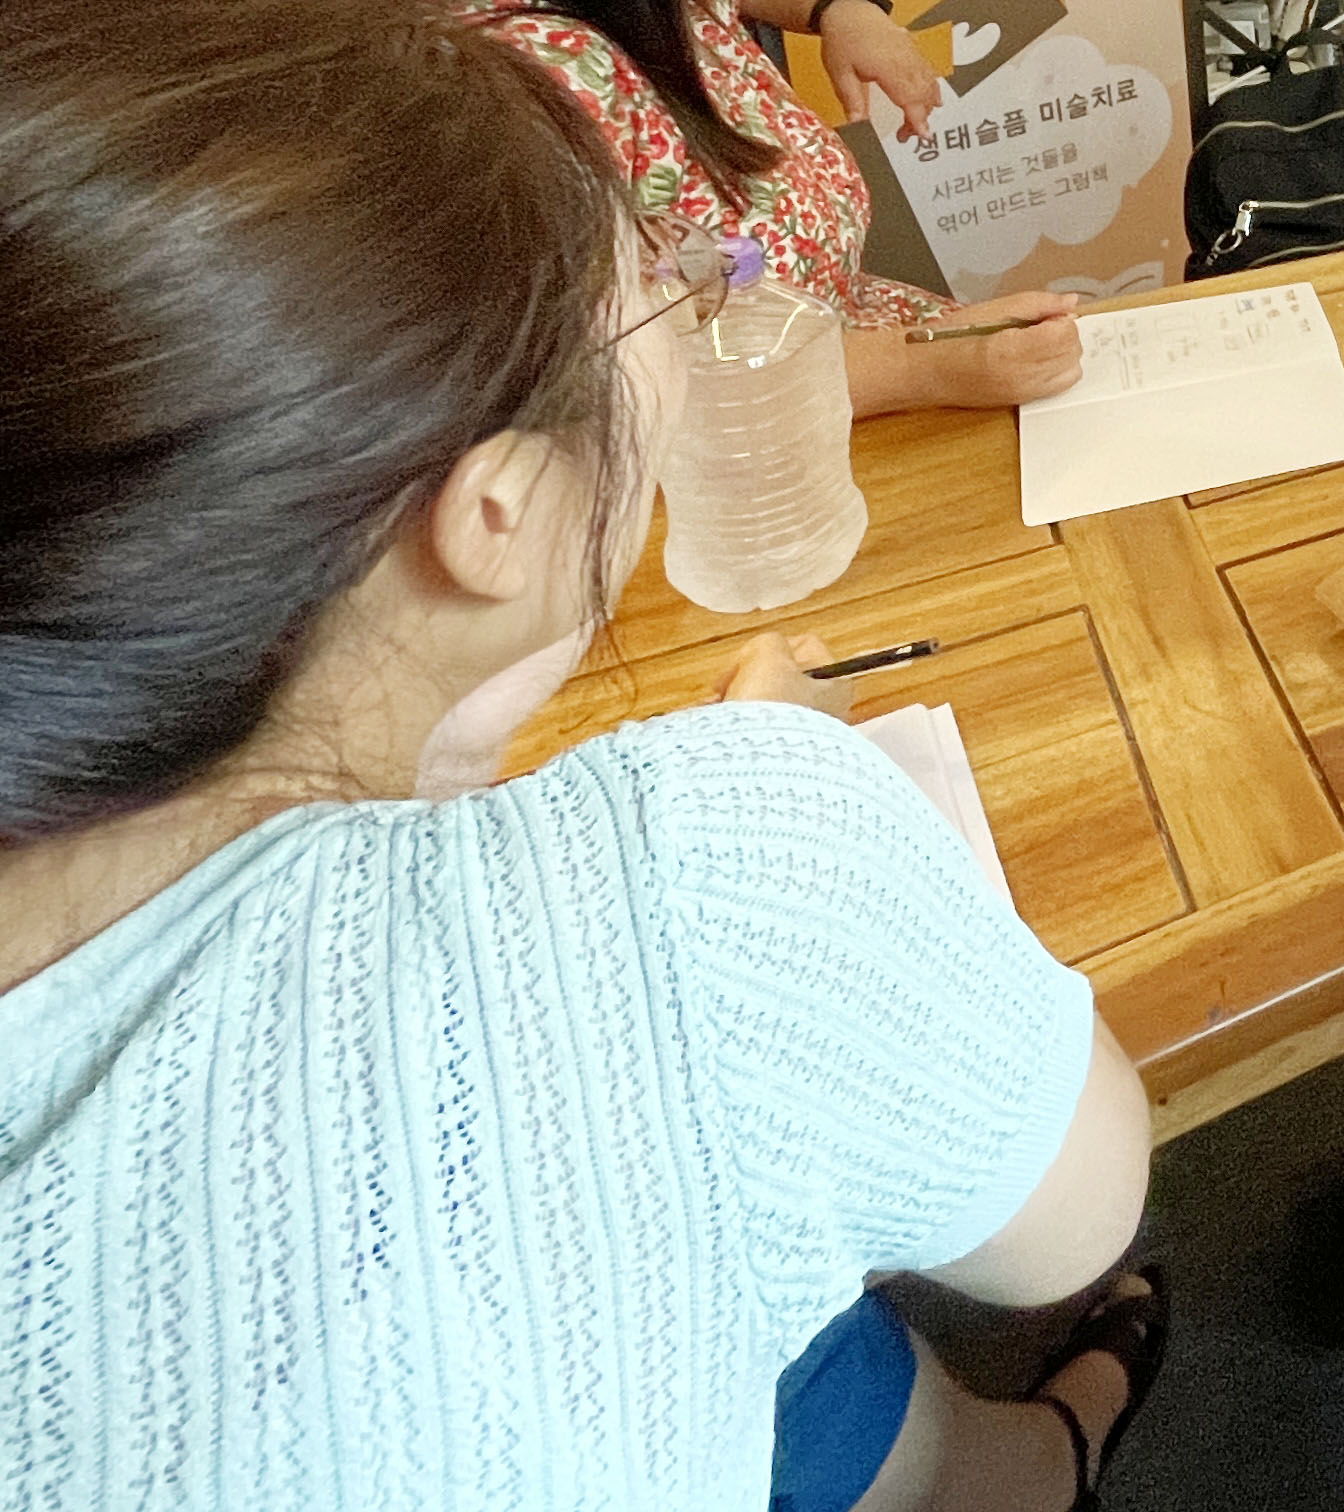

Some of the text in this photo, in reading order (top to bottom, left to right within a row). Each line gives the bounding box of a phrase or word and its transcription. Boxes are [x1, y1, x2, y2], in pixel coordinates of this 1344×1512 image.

[913, 79, 1138, 163] 생태슬픔 미술치료
[932, 142, 1078, 202] 사라지는 것들을
[936, 163, 1110, 235] 엮어 만드는 그림책
